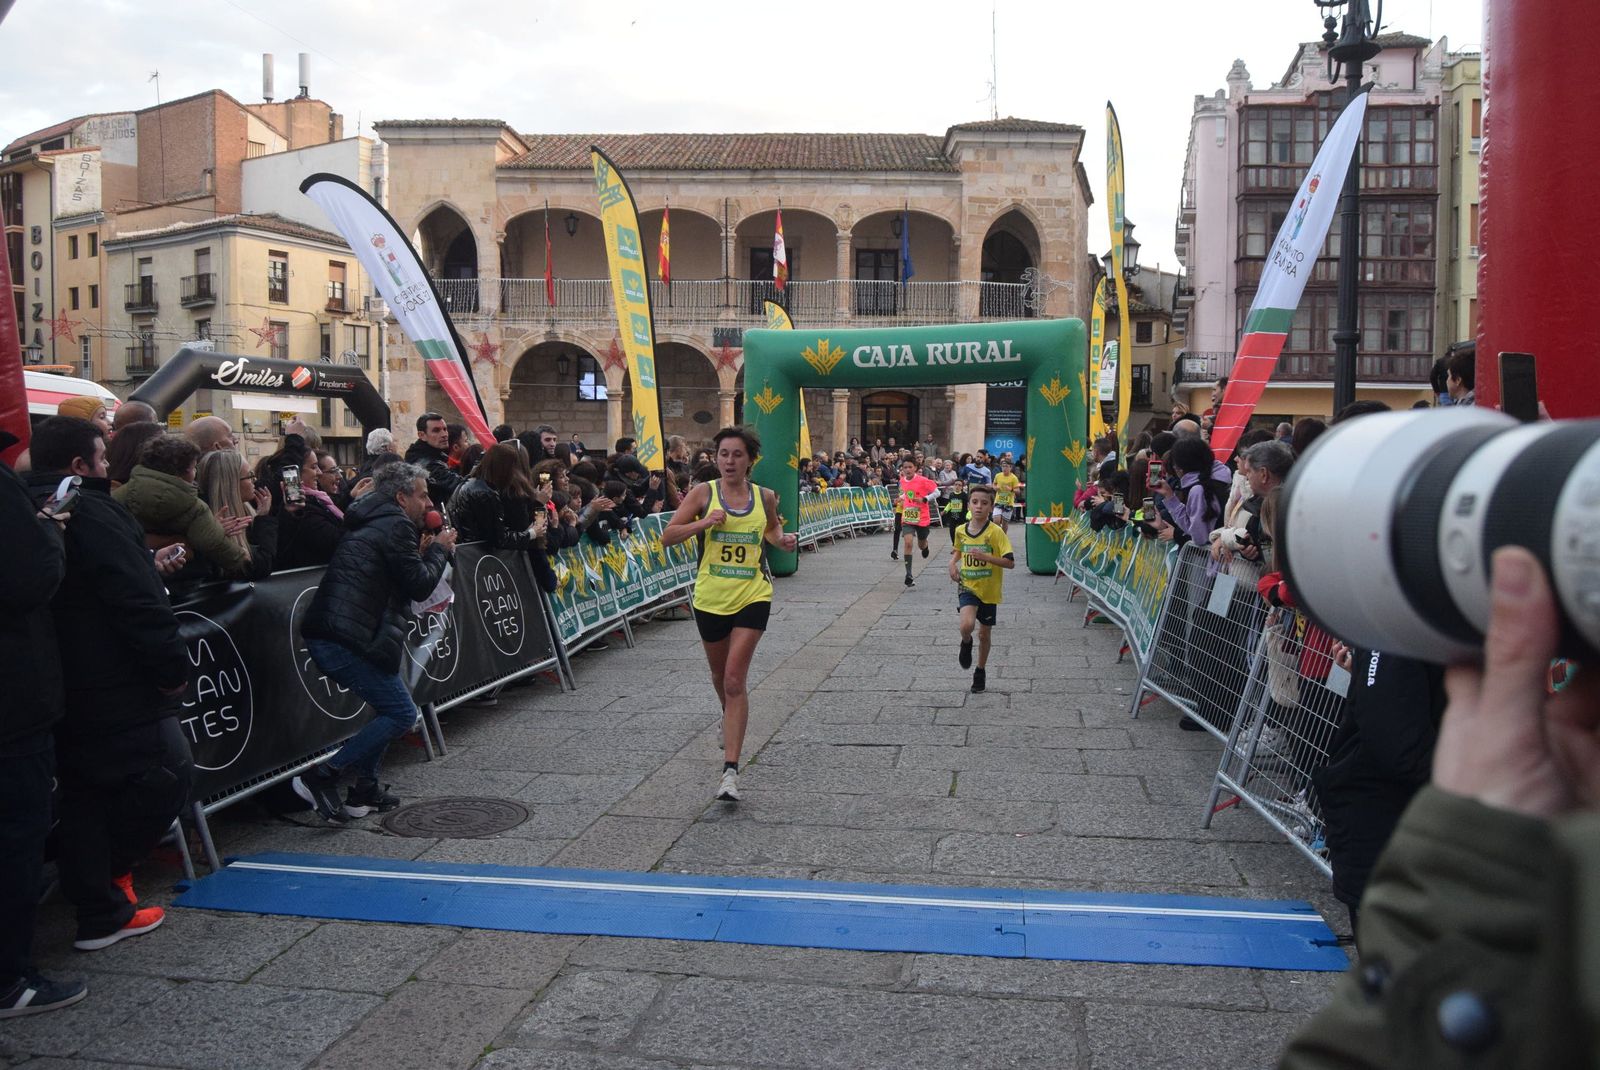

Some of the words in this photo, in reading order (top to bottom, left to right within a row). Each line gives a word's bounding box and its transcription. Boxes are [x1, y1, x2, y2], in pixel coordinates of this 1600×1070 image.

[71, 153, 92, 202] BOIZAS
[852, 344, 919, 369] CAJA
[925, 339, 1022, 366] RURAL
[210, 357, 285, 388] Smiles
[994, 439, 1014, 449] 016
[904, 510, 919, 519] 1053
[721, 545, 746, 564] 59
[482, 593, 519, 618] PLAN
[494, 616, 520, 638] TES
[420, 636, 452, 661] TES
[1367, 650, 1380, 687] Joma
[181, 705, 239, 743] TES
